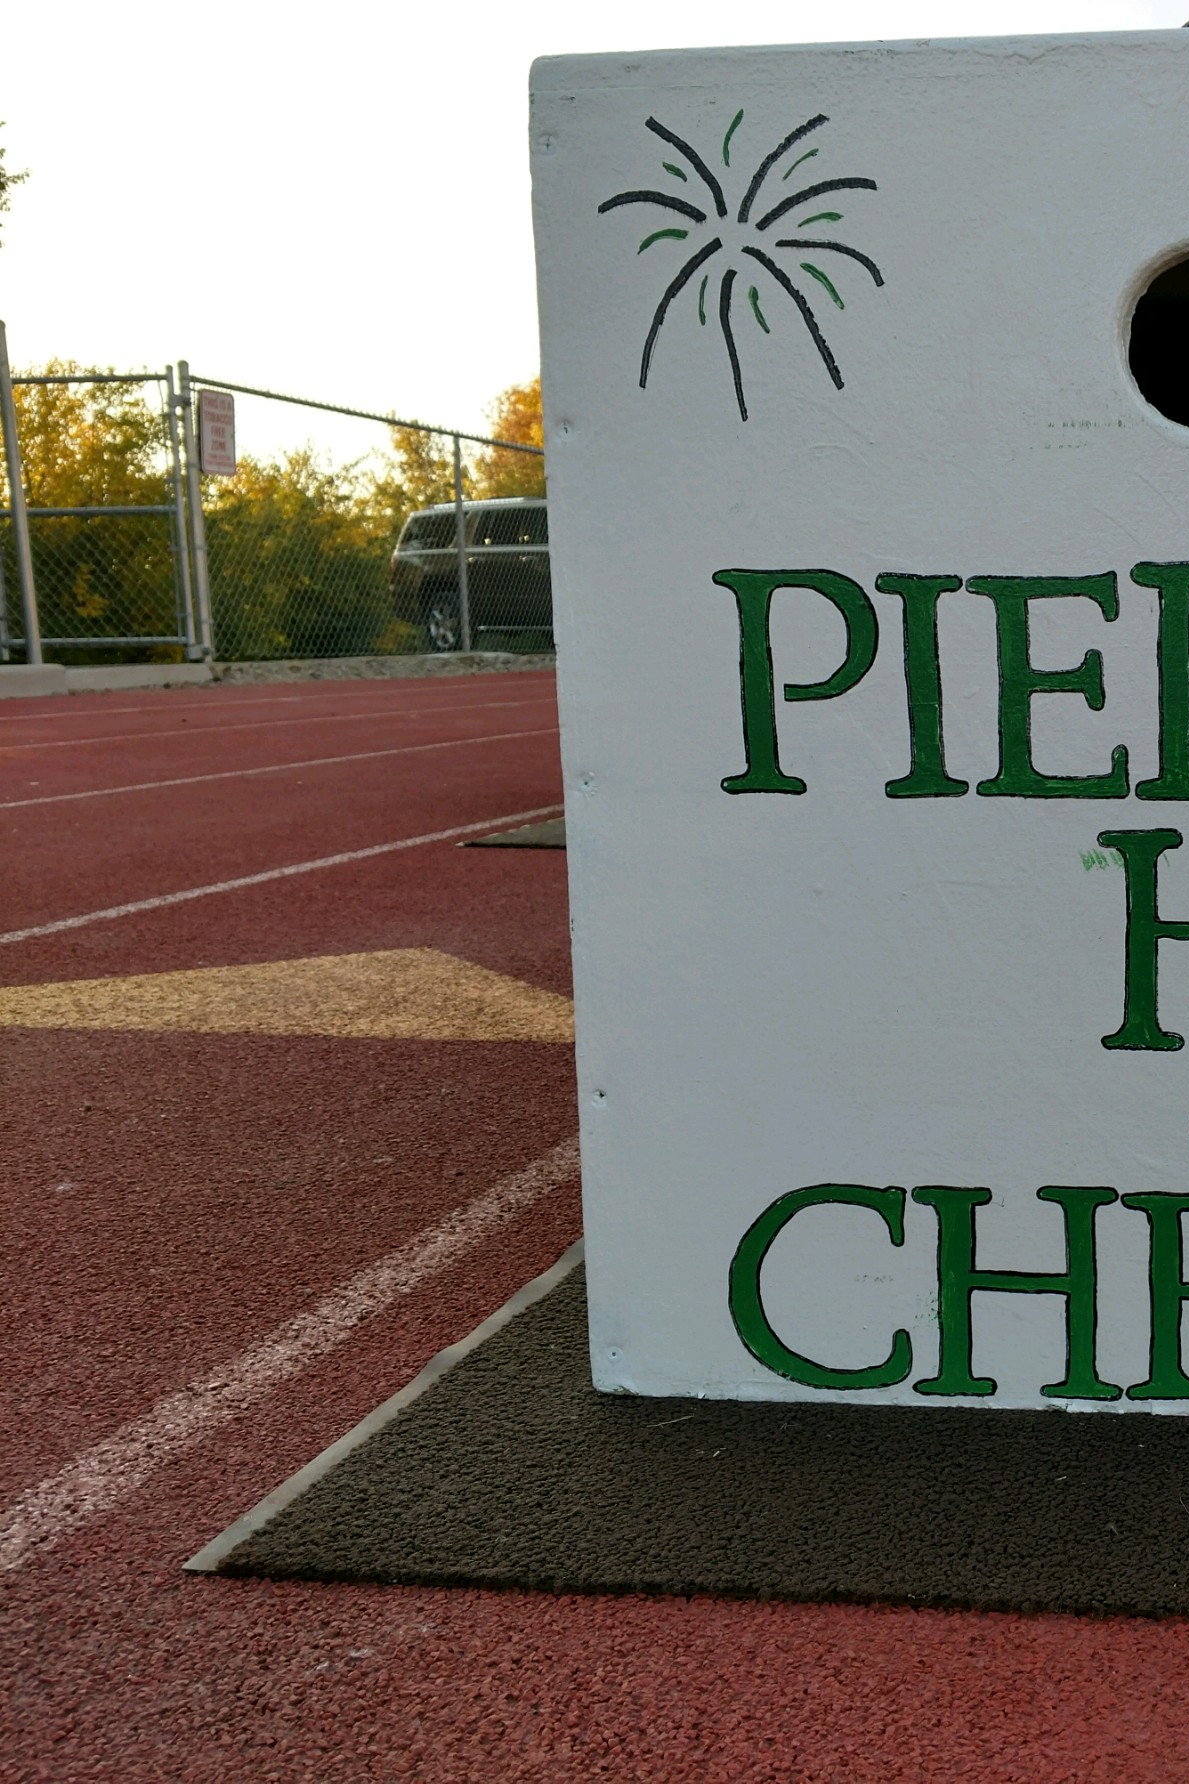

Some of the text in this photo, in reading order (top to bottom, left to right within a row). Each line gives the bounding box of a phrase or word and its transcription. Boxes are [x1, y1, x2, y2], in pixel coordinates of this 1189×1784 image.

[204, 410, 232, 425] TOBACCO
[211, 425, 225, 438] FREE
[211, 439, 226, 451] ZONE
